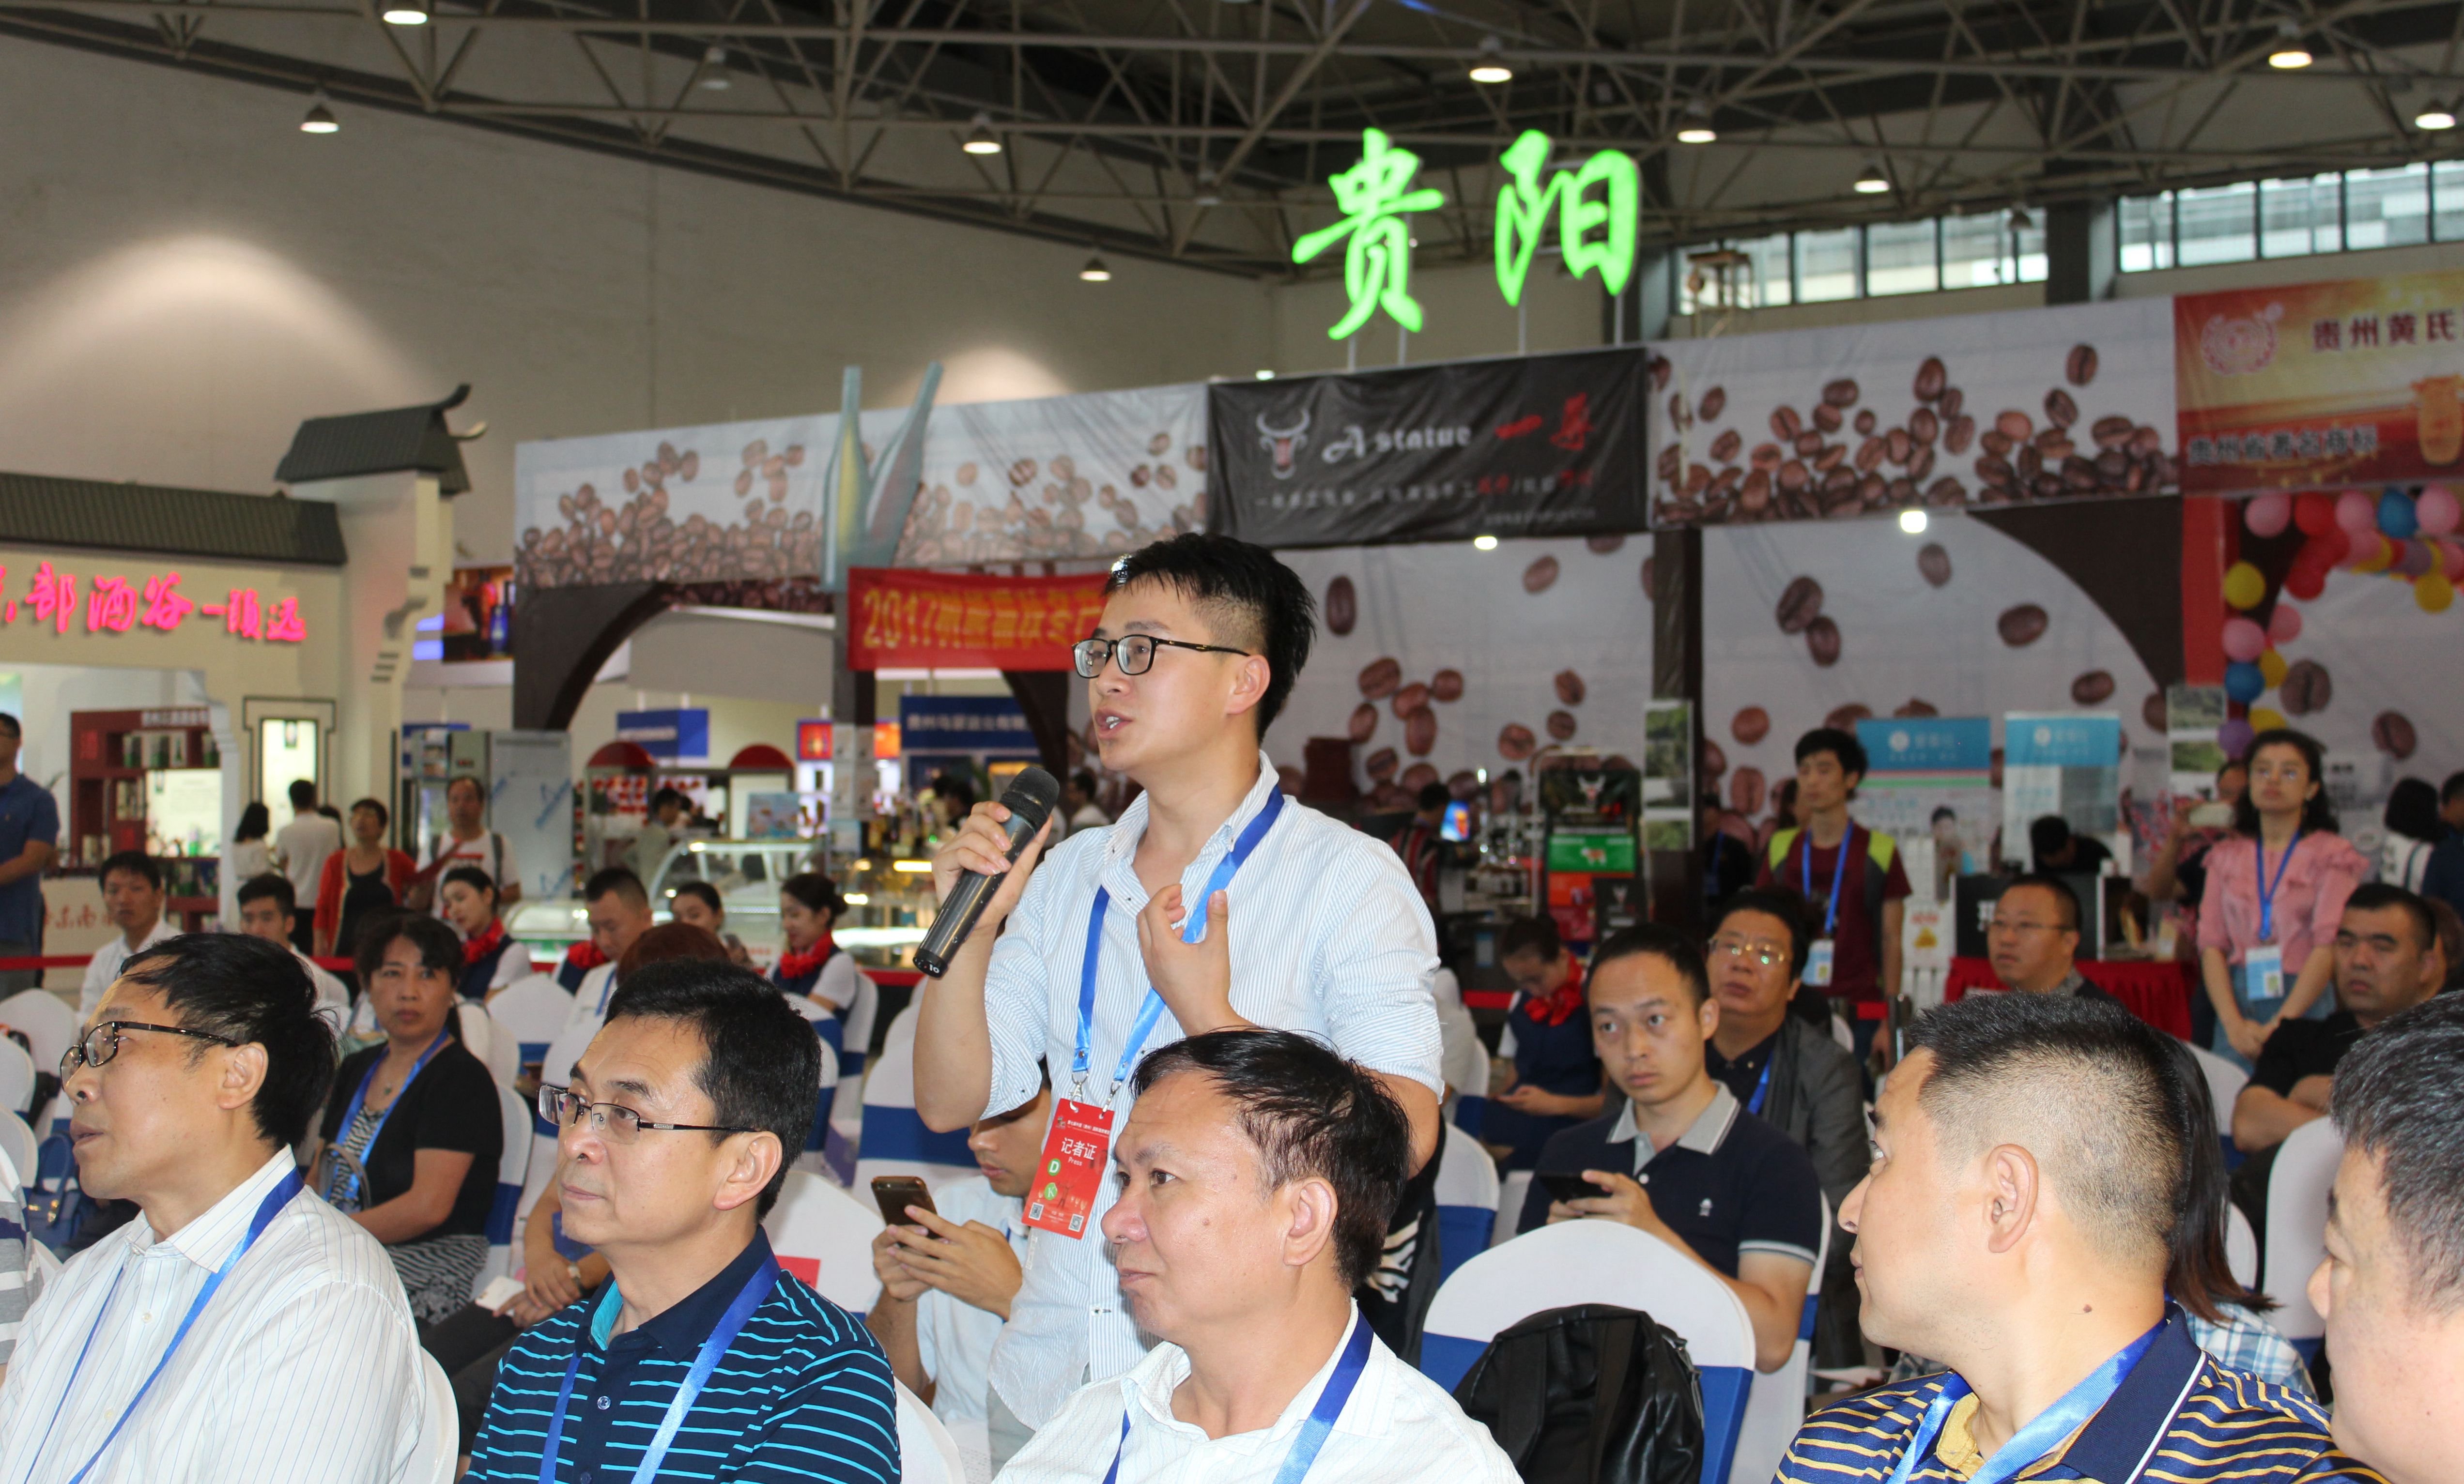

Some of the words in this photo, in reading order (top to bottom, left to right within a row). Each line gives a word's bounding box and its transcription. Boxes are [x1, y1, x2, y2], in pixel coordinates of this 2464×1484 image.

[1292, 127, 1639, 340] 贵阳
[2312, 309, 2464, 352] 贵州黄氏
[1061, 1137, 1098, 1160] 记者证
[1049, 1160, 1060, 1174] D
[1068, 1156, 1082, 1166] Press
